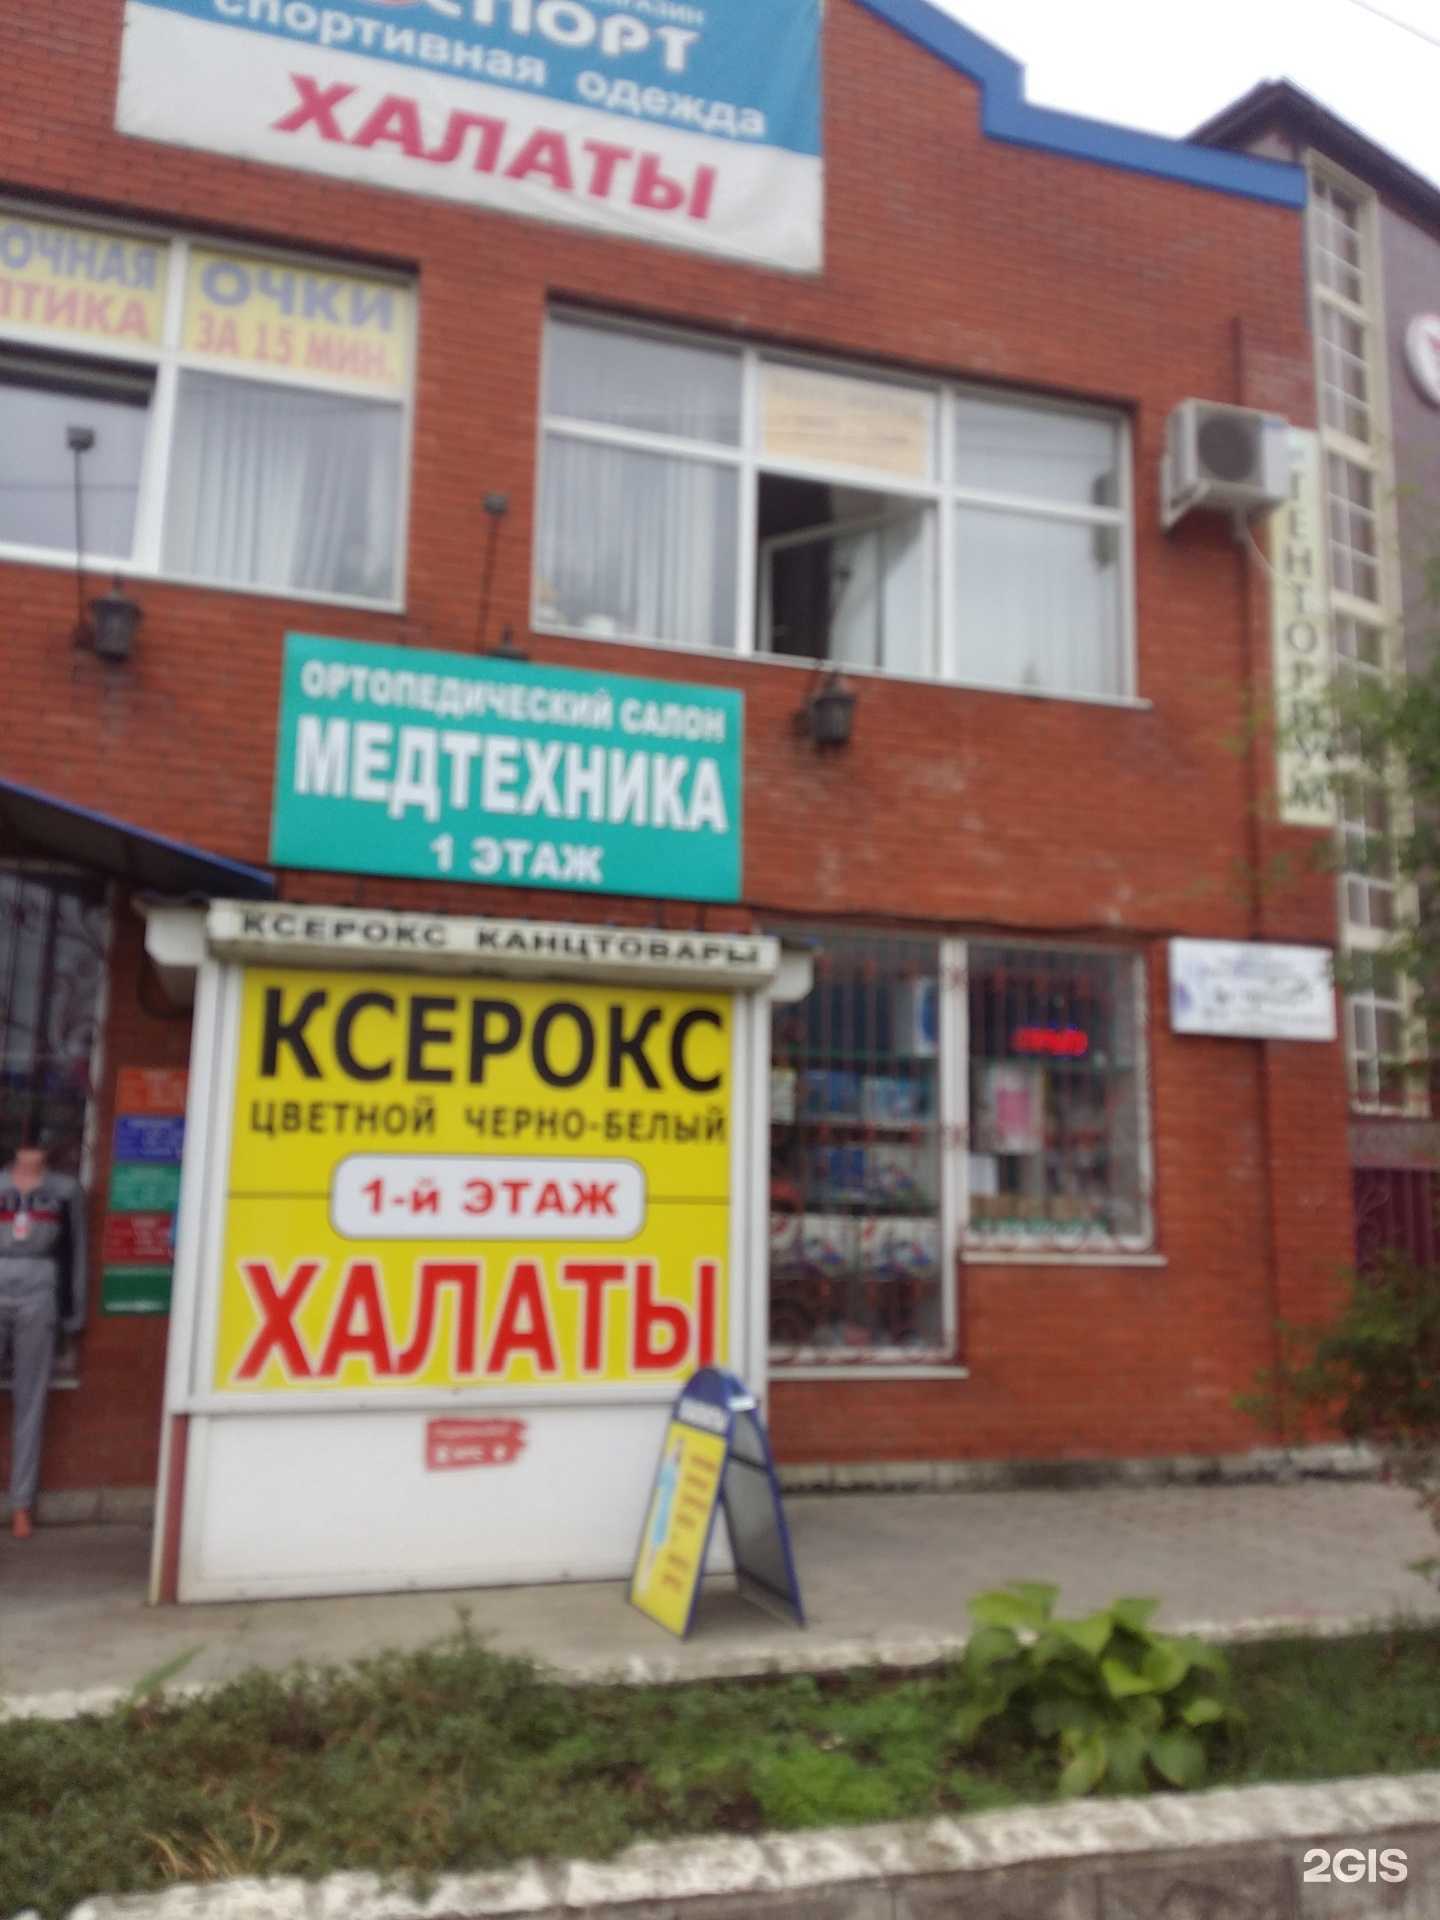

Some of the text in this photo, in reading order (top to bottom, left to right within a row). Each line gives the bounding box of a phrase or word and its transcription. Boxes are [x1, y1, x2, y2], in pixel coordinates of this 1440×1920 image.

[576, 69, 766, 134] одежда
[272, 71, 716, 220] ХАЛАТЫ
[202, 260, 393, 332] ОЧКИ
[196, 313, 239, 354] ЗА
[255, 324, 294, 365] 15
[300, 659, 726, 743] ОРТОПЕДИЧЕСКИЙ САЛОН
[293, 713, 728, 835] МЕДТЕХНИКА
[430, 834, 605, 884] 1 ЭТАЖ
[241, 910, 760, 966] КСЕРОКС КАНЦТОВАРЫ
[258, 986, 726, 1093] КСЕРОКС
[249, 1095, 727, 1147] ЦВЕТНОЙ ЧЕРНО-БЕЛЫЙ
[360, 1178, 618, 1218] 1-й ЭТАЖ
[234, 1263, 717, 1382] ХАЛАТЫ
